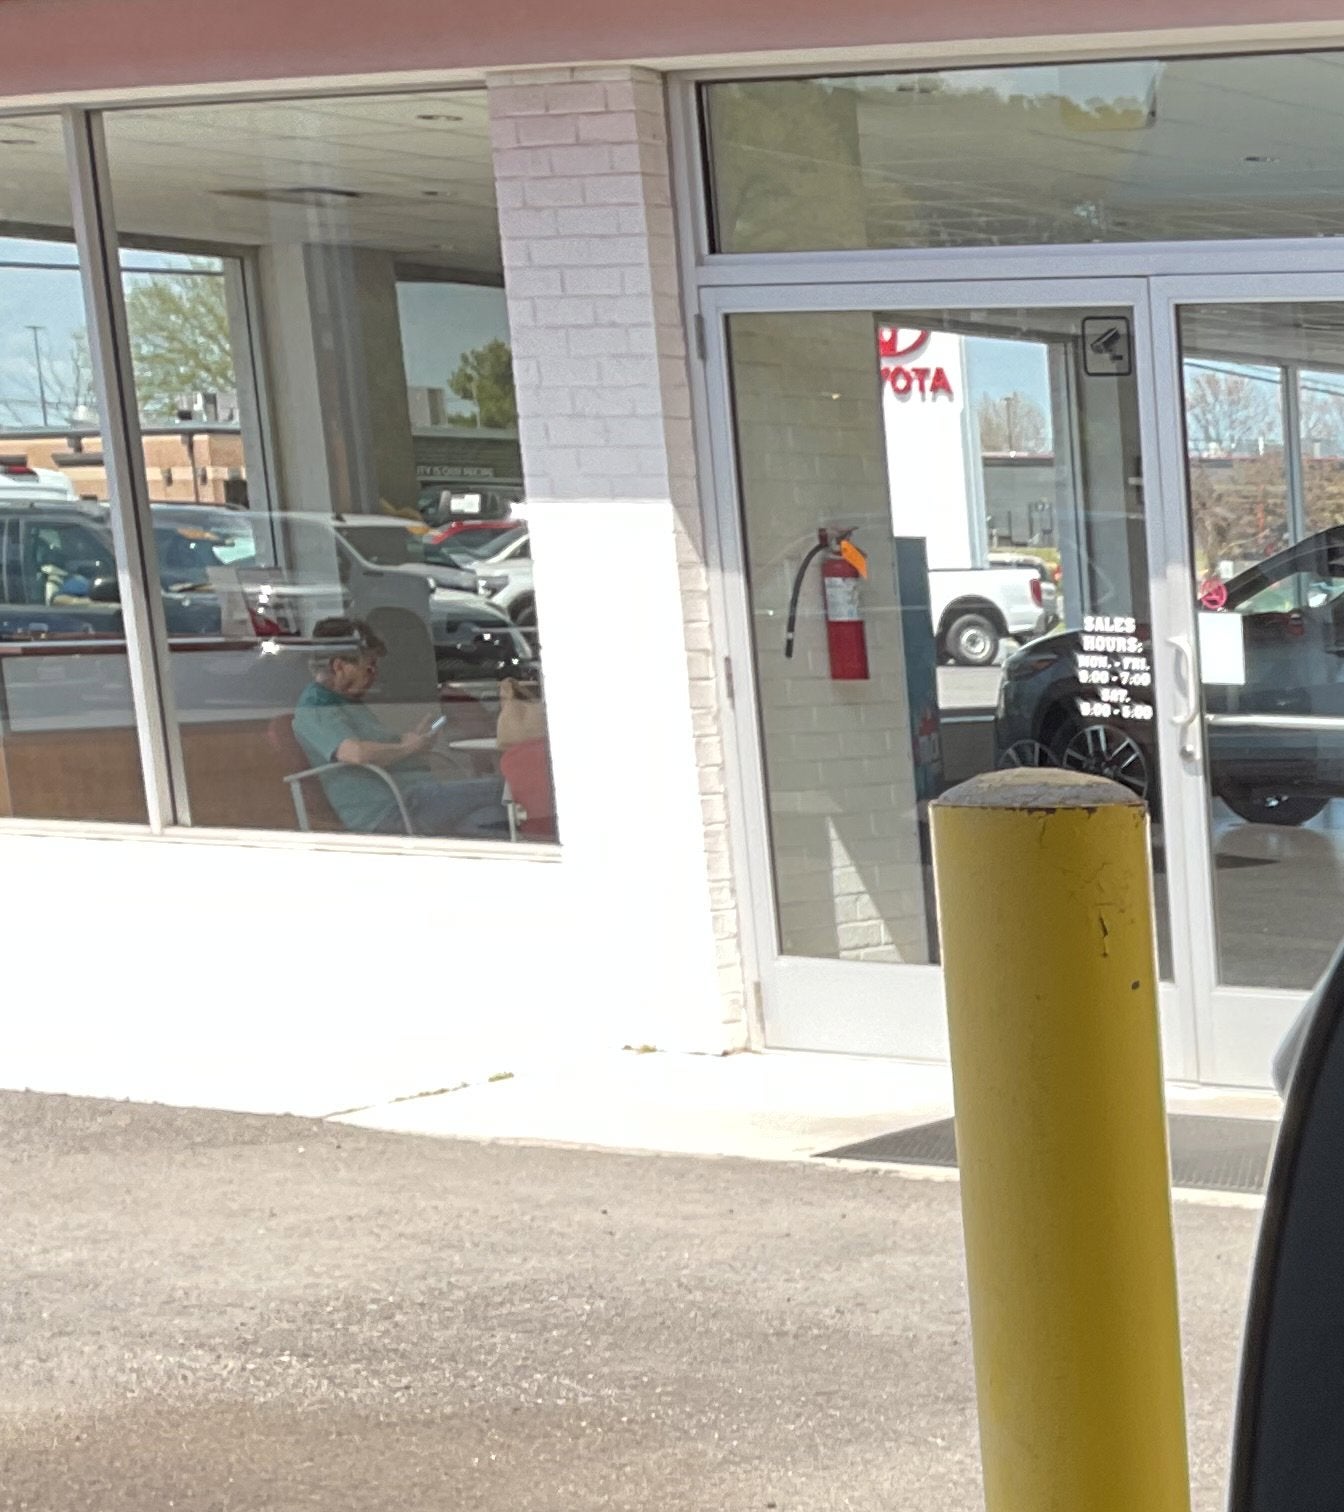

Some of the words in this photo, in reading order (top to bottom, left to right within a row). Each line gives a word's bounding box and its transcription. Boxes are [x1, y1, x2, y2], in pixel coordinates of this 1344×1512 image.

[1083, 615, 1136, 633] SALES
[1082, 635, 1144, 653] HOURS:
[1076, 654, 1112, 668] MON.
[1122, 657, 1151, 670] FRI.
[1119, 671, 1152, 687] 7:00
[1100, 687, 1131, 703] SAT.
